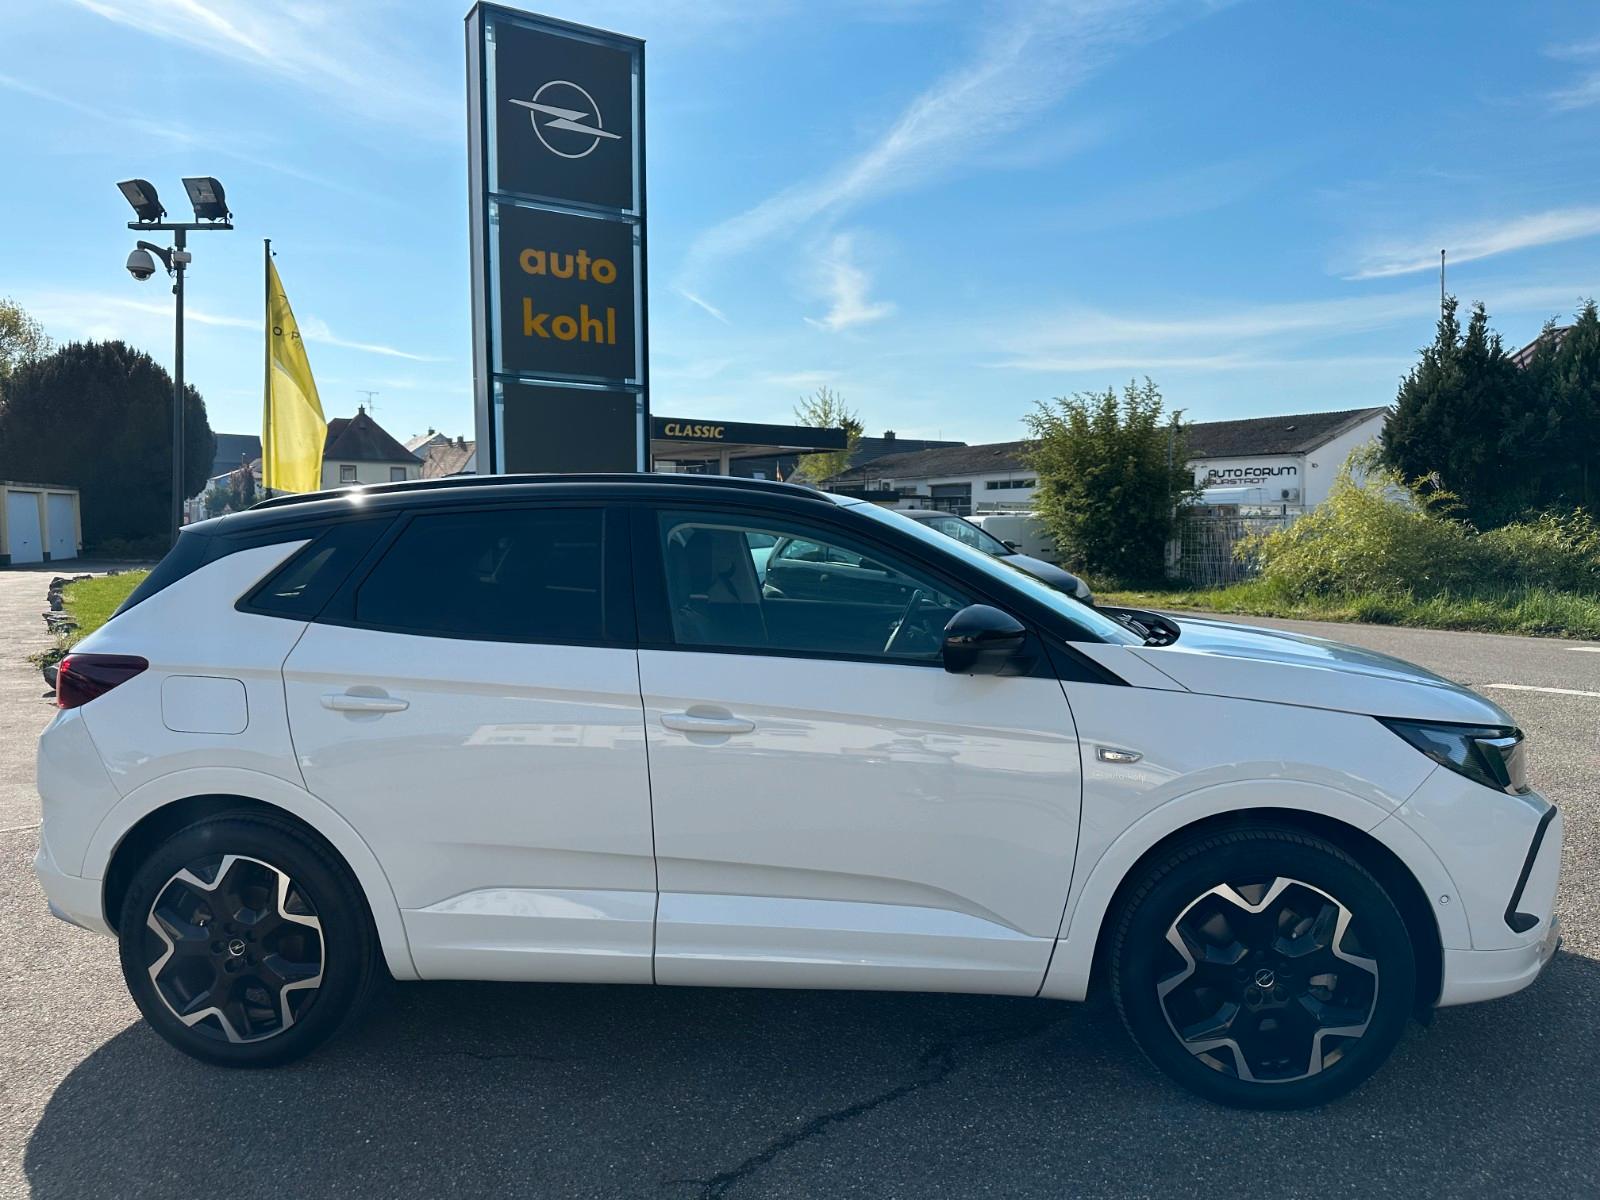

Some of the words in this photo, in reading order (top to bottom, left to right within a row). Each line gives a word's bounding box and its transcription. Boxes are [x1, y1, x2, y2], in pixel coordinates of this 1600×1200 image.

[519, 248, 617, 284] auto
[523, 297, 616, 344] kohl
[664, 423, 725, 439] CLASSIC
